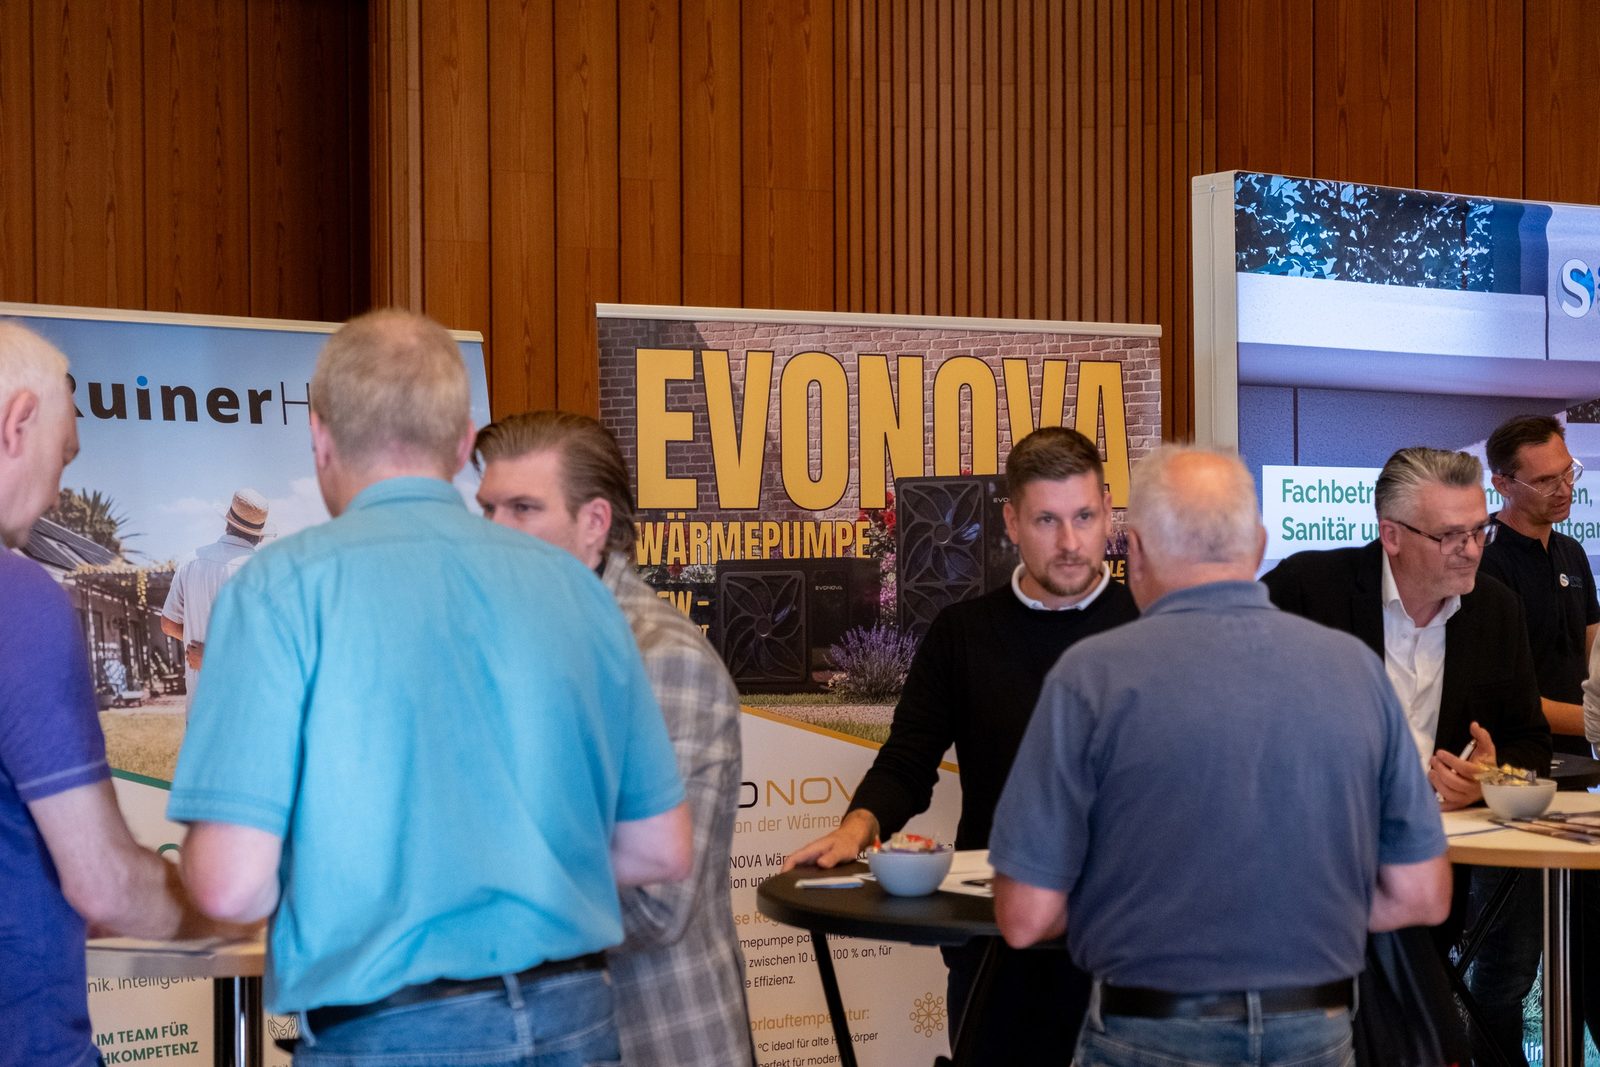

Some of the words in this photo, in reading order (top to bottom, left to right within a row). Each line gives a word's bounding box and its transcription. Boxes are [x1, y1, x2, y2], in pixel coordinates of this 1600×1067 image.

[636, 347, 1131, 511] EVONOVA
[1282, 479, 1379, 504] Fachbetr
[635, 511, 871, 566] WÄRMEPUMPE
[1282, 517, 1356, 541] Sanitär
[758, 816, 782, 832] der
[787, 814, 844, 830] Wärme
[765, 853, 790, 867] Wär
[738, 934, 794, 950] mepumpe
[749, 952, 796, 968] zwischen
[798, 952, 808, 963] 10
[832, 948, 849, 960] 100
[851, 948, 859, 958] %
[861, 946, 876, 958] an,
[879, 944, 892, 956] für
[754, 973, 796, 988] Effizienz.
[96, 1032, 115, 1047] IM
[117, 1026, 158, 1044] TEAM
[161, 1021, 189, 1039] FÜR
[771, 1040, 795, 1052] ideal
[797, 1036, 809, 1049] für
[811, 1035, 829, 1047] alte
